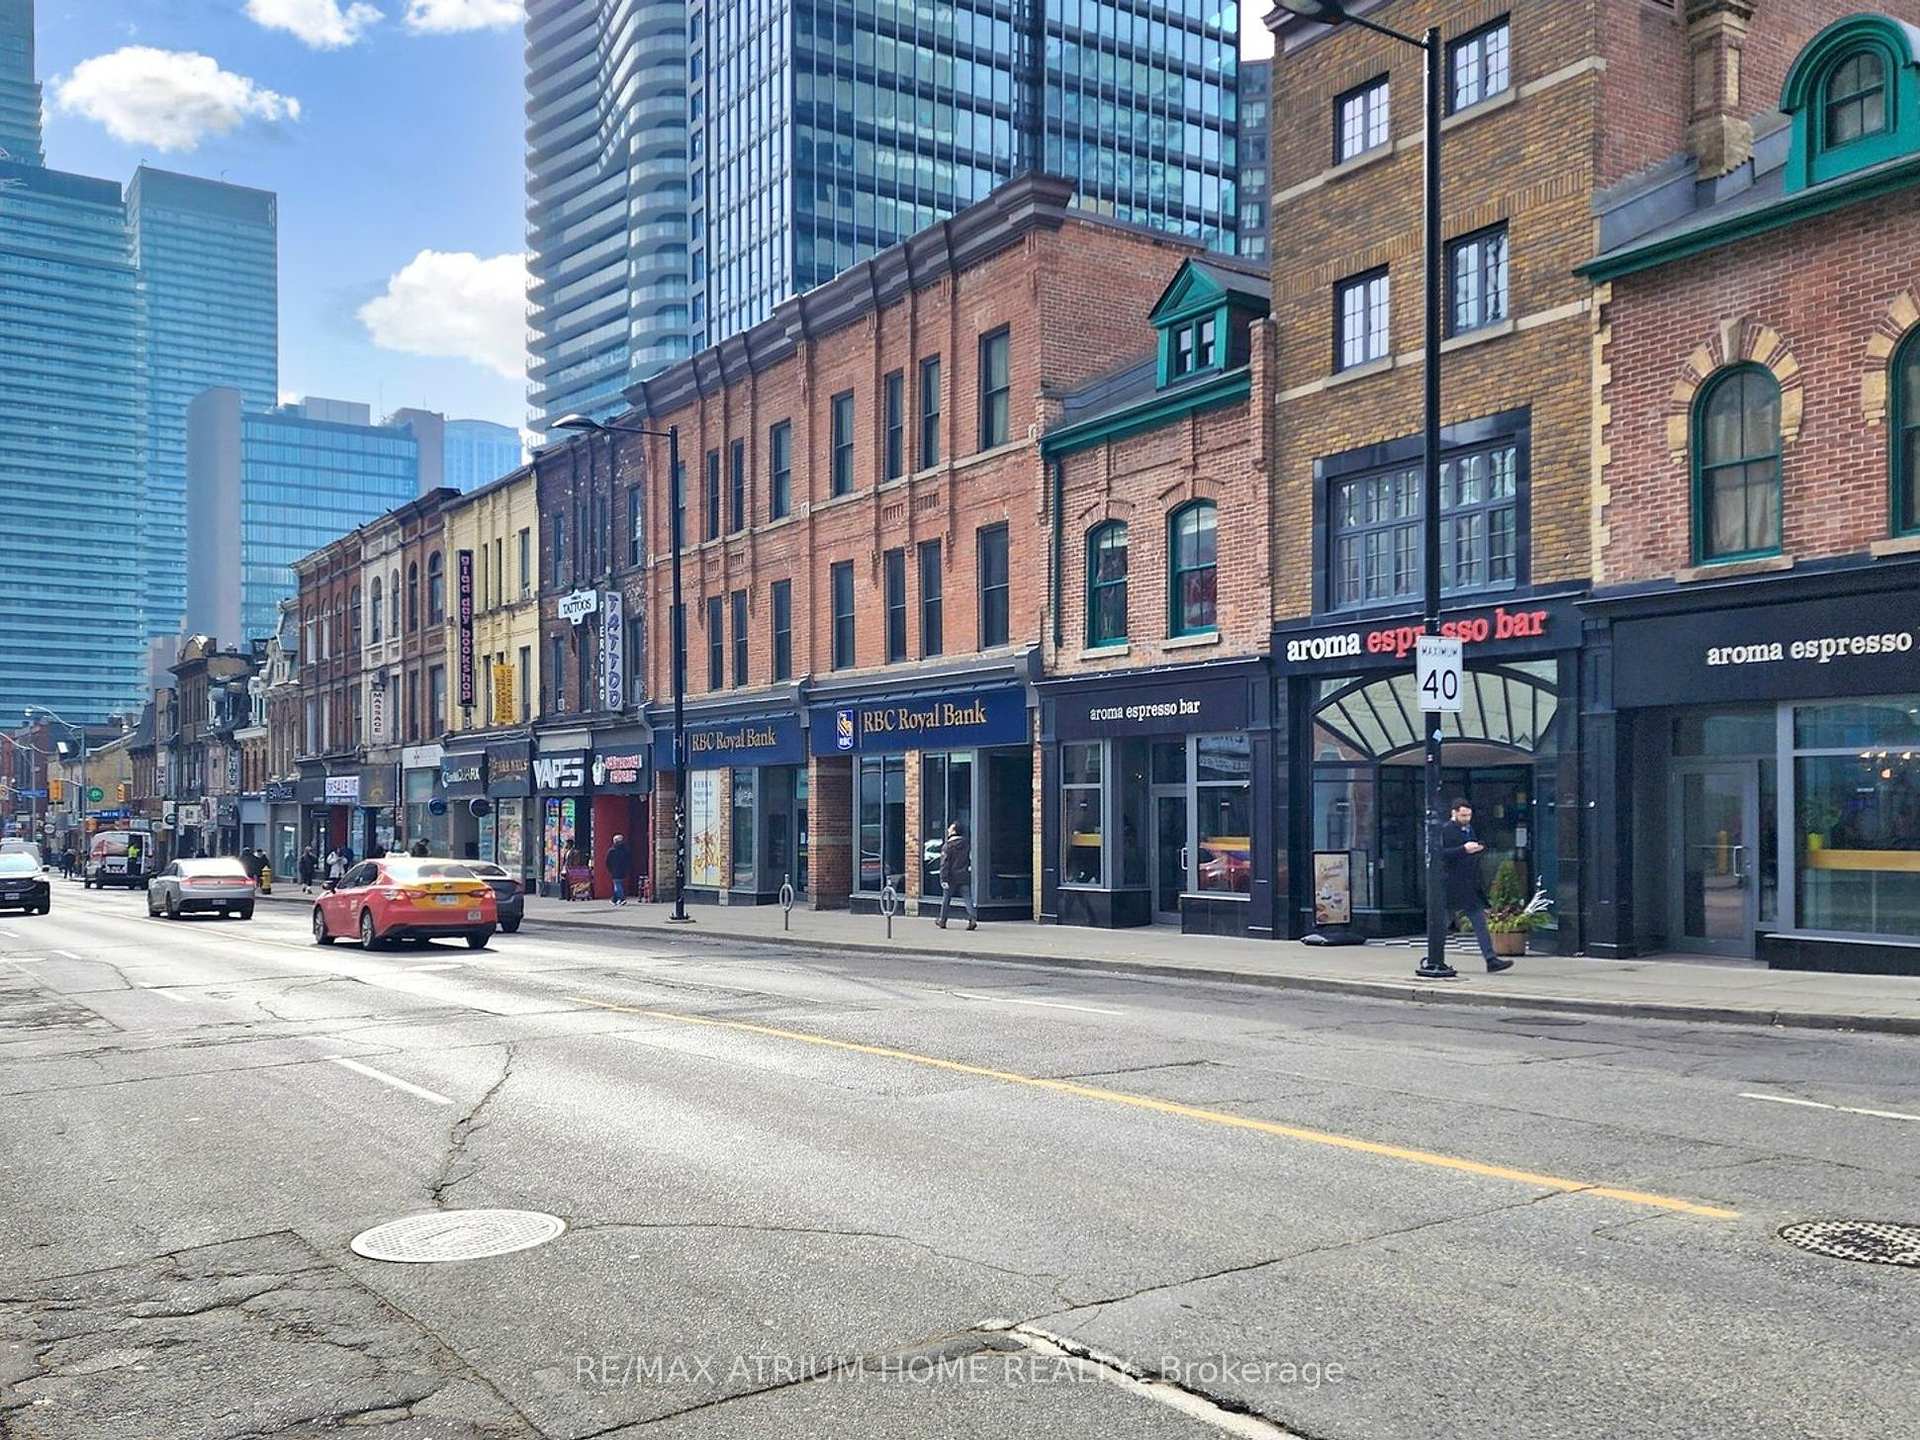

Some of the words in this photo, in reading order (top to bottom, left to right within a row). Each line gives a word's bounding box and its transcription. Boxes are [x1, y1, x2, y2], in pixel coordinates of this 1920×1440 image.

[562, 599, 592, 615] TATTOOS
[607, 594, 621, 708] TATTOO
[1287, 633, 1361, 661] aroma
[1367, 618, 1489, 659] esprsso
[1494, 608, 1548, 639] bar
[1707, 642, 1785, 666] aroma
[1790, 631, 1913, 664] espresso
[1422, 669, 1458, 700] 40
[373, 692, 382, 733] MASSAGE
[863, 709, 896, 733] RBC
[898, 703, 941, 734] Royal
[943, 698, 987, 726] Bank
[1089, 706, 1124, 721] aroma
[1126, 703, 1178, 722] espresso
[1179, 698, 1201, 714] bar
[692, 732, 715, 752] RBC
[716, 728, 745, 753] Royal
[747, 725, 777, 748] Bank
[533, 757, 585, 789] VAPES
